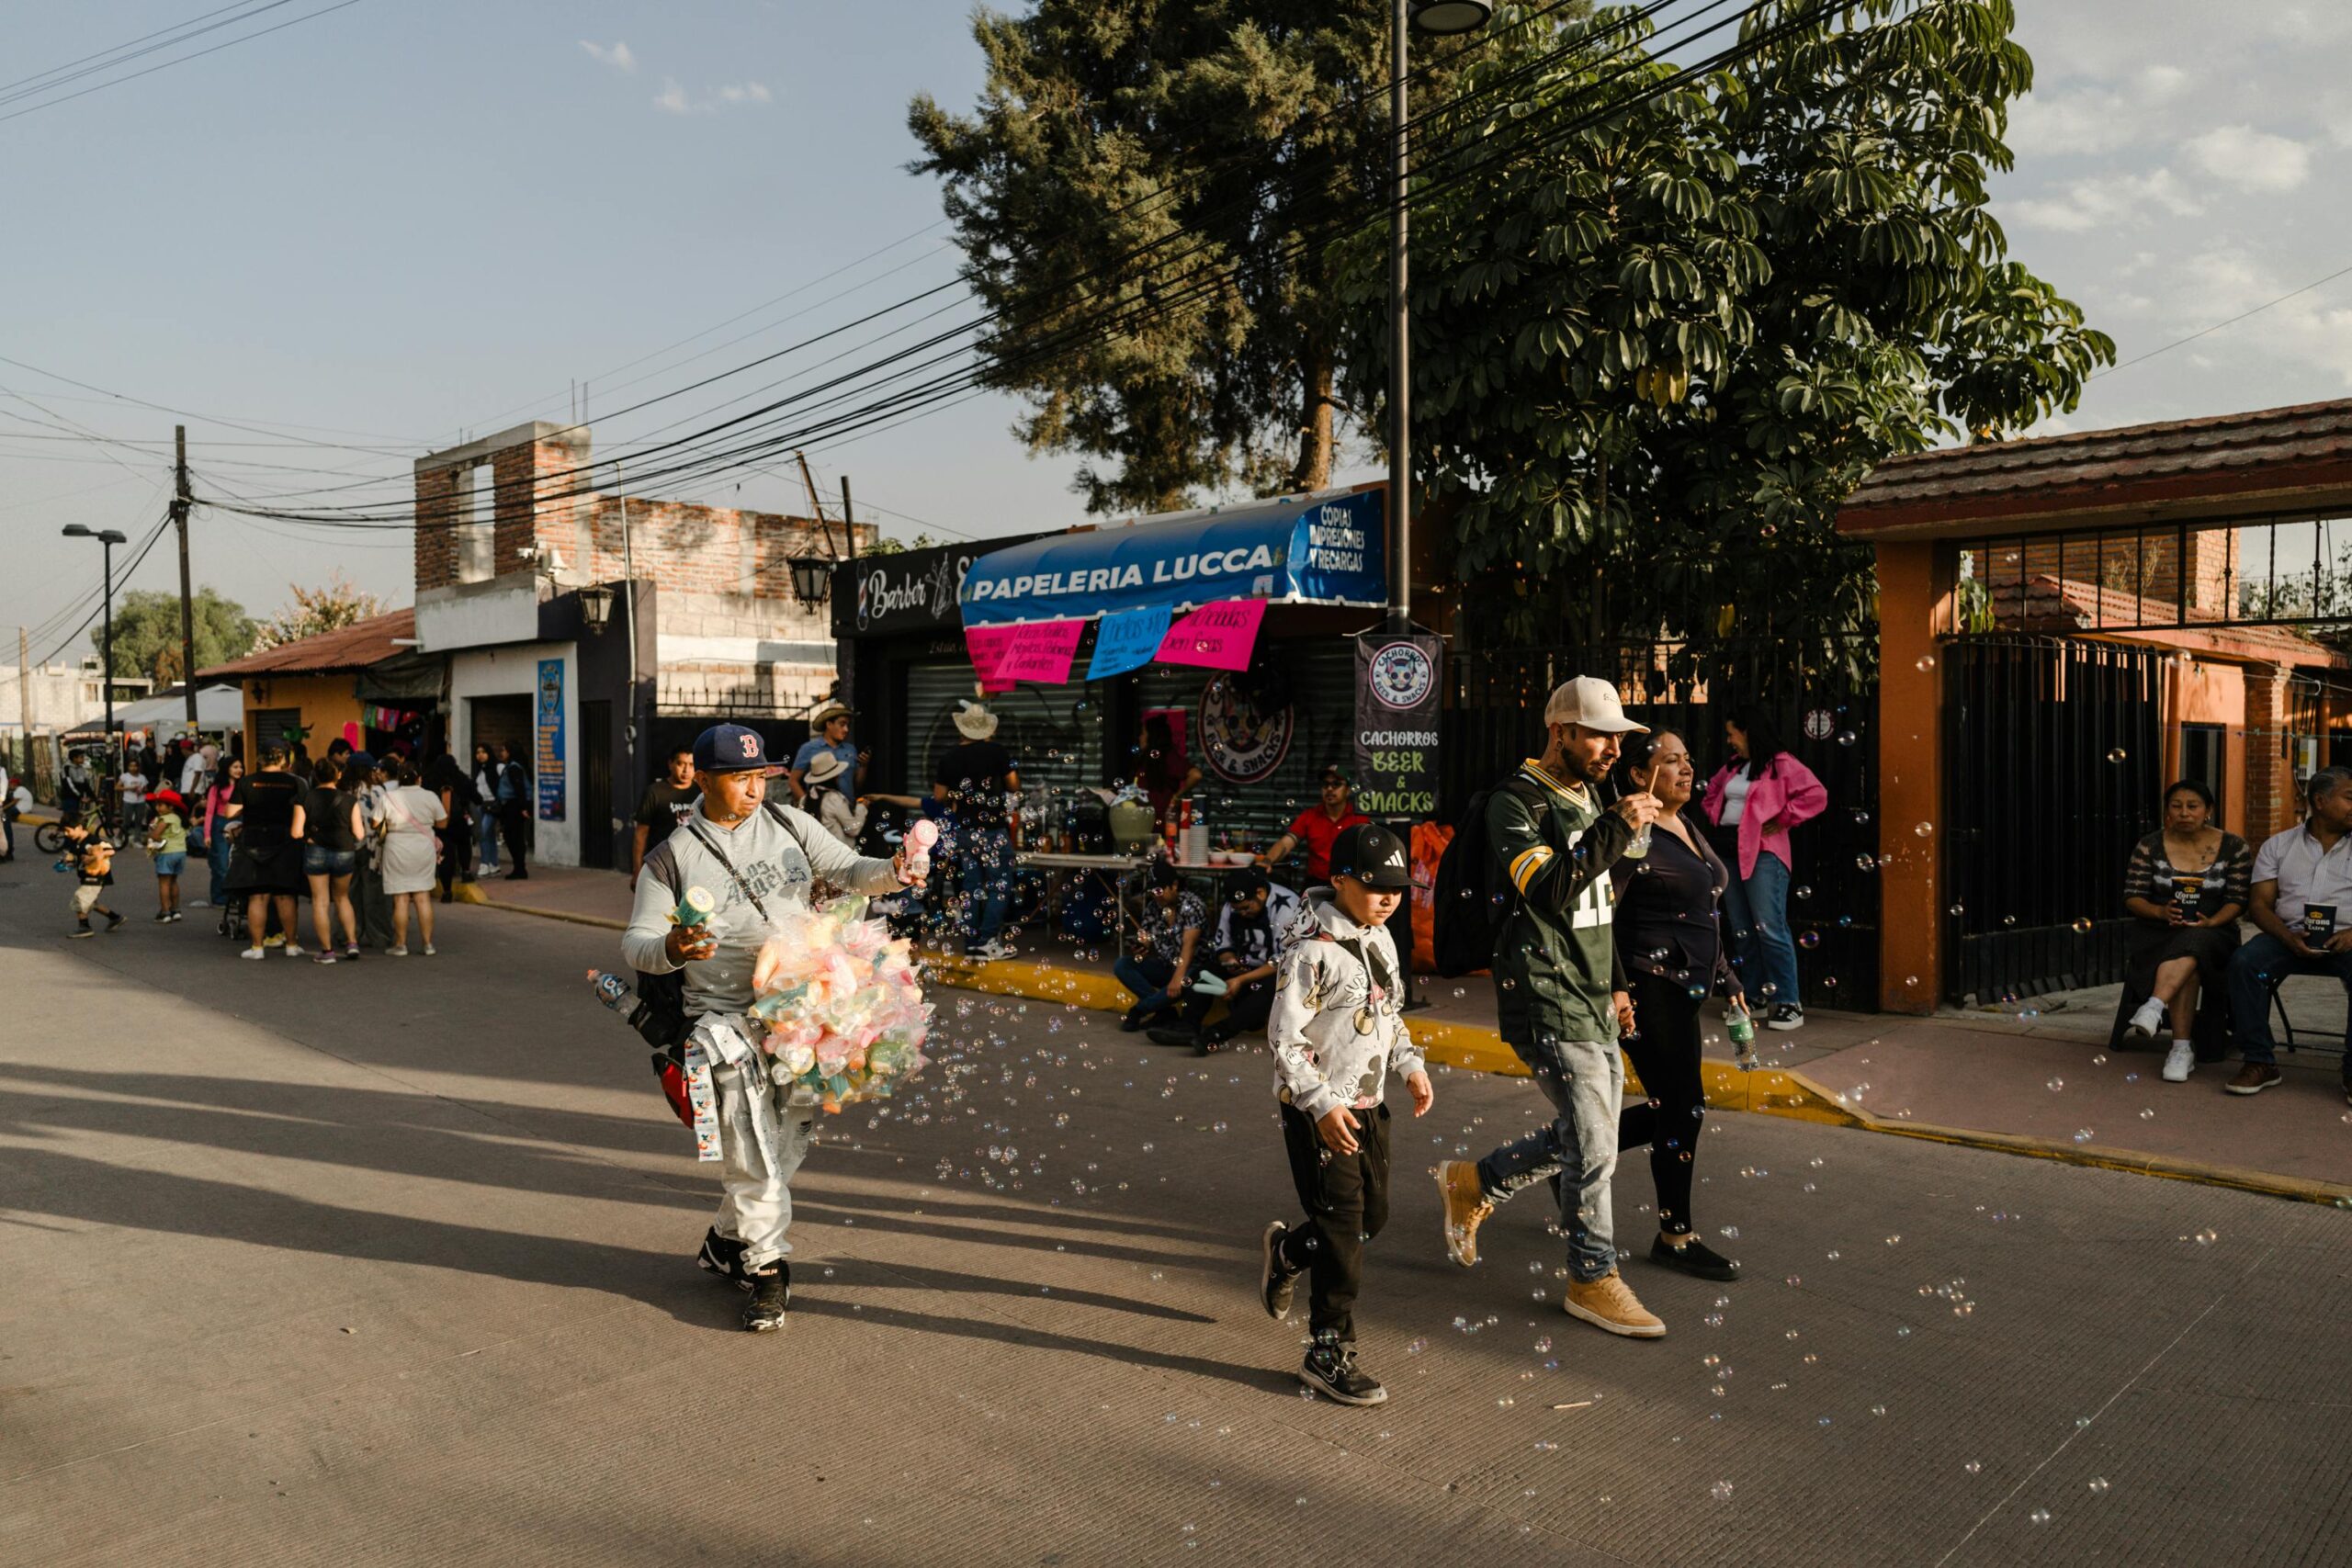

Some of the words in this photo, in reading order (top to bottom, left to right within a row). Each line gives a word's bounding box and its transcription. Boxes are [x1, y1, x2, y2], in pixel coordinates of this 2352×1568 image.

[1320, 505, 1351, 528] COPIAS
[1309, 525, 1365, 550] IMPRESIONES
[1309, 547, 1317, 569] Y
[1317, 549, 1363, 572] RECARGAS
[972, 564, 1144, 602] PAPELERIA
[1152, 544, 1274, 583] LUCCA
[868, 570, 926, 619] Barber
[1377, 648, 1425, 668] CACHORROS
[1374, 681, 1390, 698] BEER
[1401, 681, 1426, 704] SNACKS
[740, 734, 760, 759] B
[1360, 730, 1439, 747] CACHORROS
[1227, 759, 1238, 773] &
[1242, 731, 1282, 773] SNACKS
[1372, 750, 1426, 773] BEER
[1396, 775, 1407, 789] &
[1358, 791, 1434, 813] SNACKS
[2174, 890, 2200, 900] Corona
